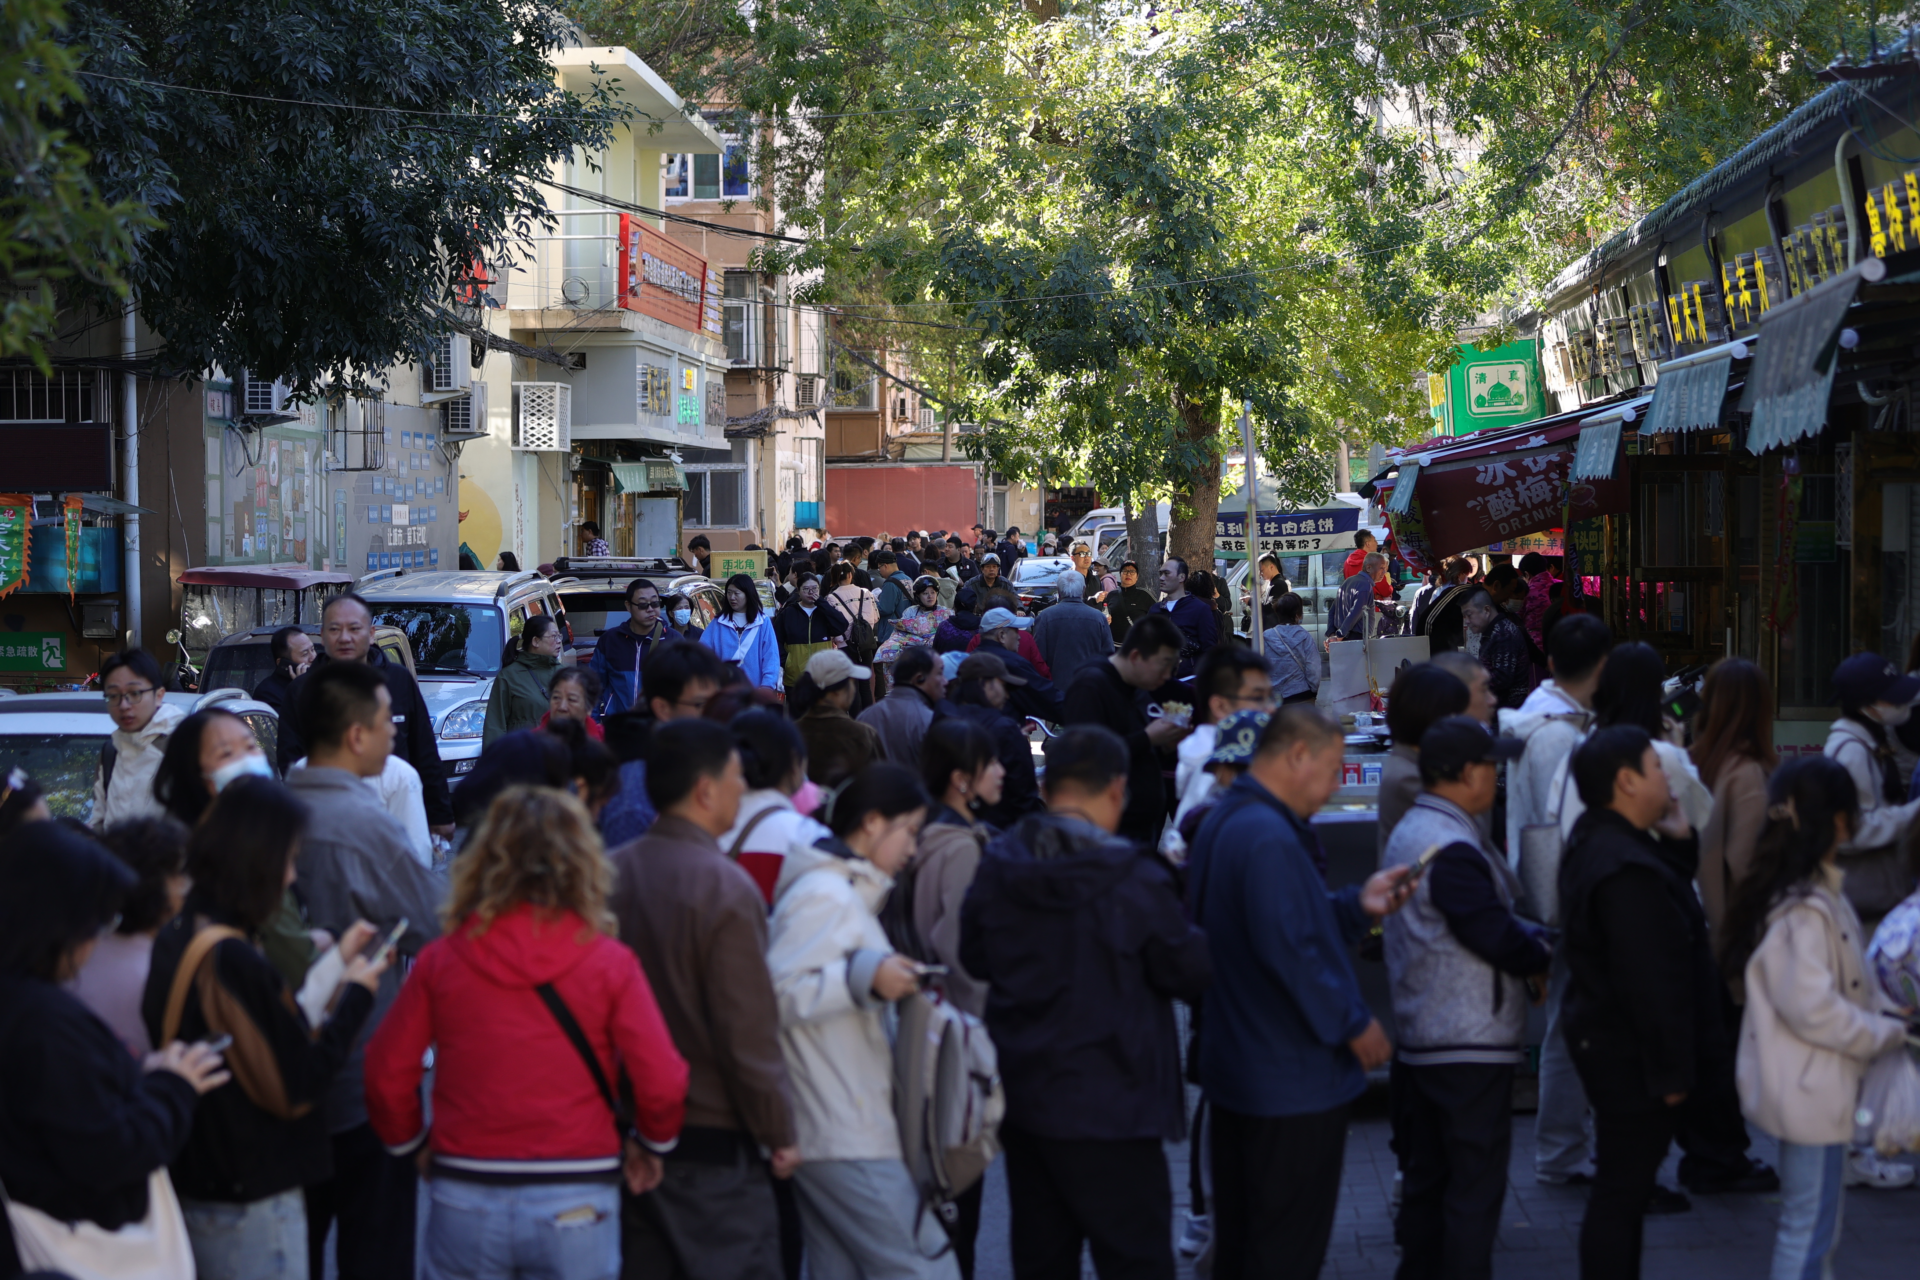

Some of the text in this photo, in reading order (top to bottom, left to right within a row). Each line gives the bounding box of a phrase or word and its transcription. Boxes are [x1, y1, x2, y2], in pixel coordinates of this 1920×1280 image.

[1475, 370, 1520, 384] 清 真
[1216, 518, 1334, 536] 顺利牛肉烧饼
[1222, 538, 1321, 551] 我在北角等你了
[722, 559, 755, 570] 西北角
